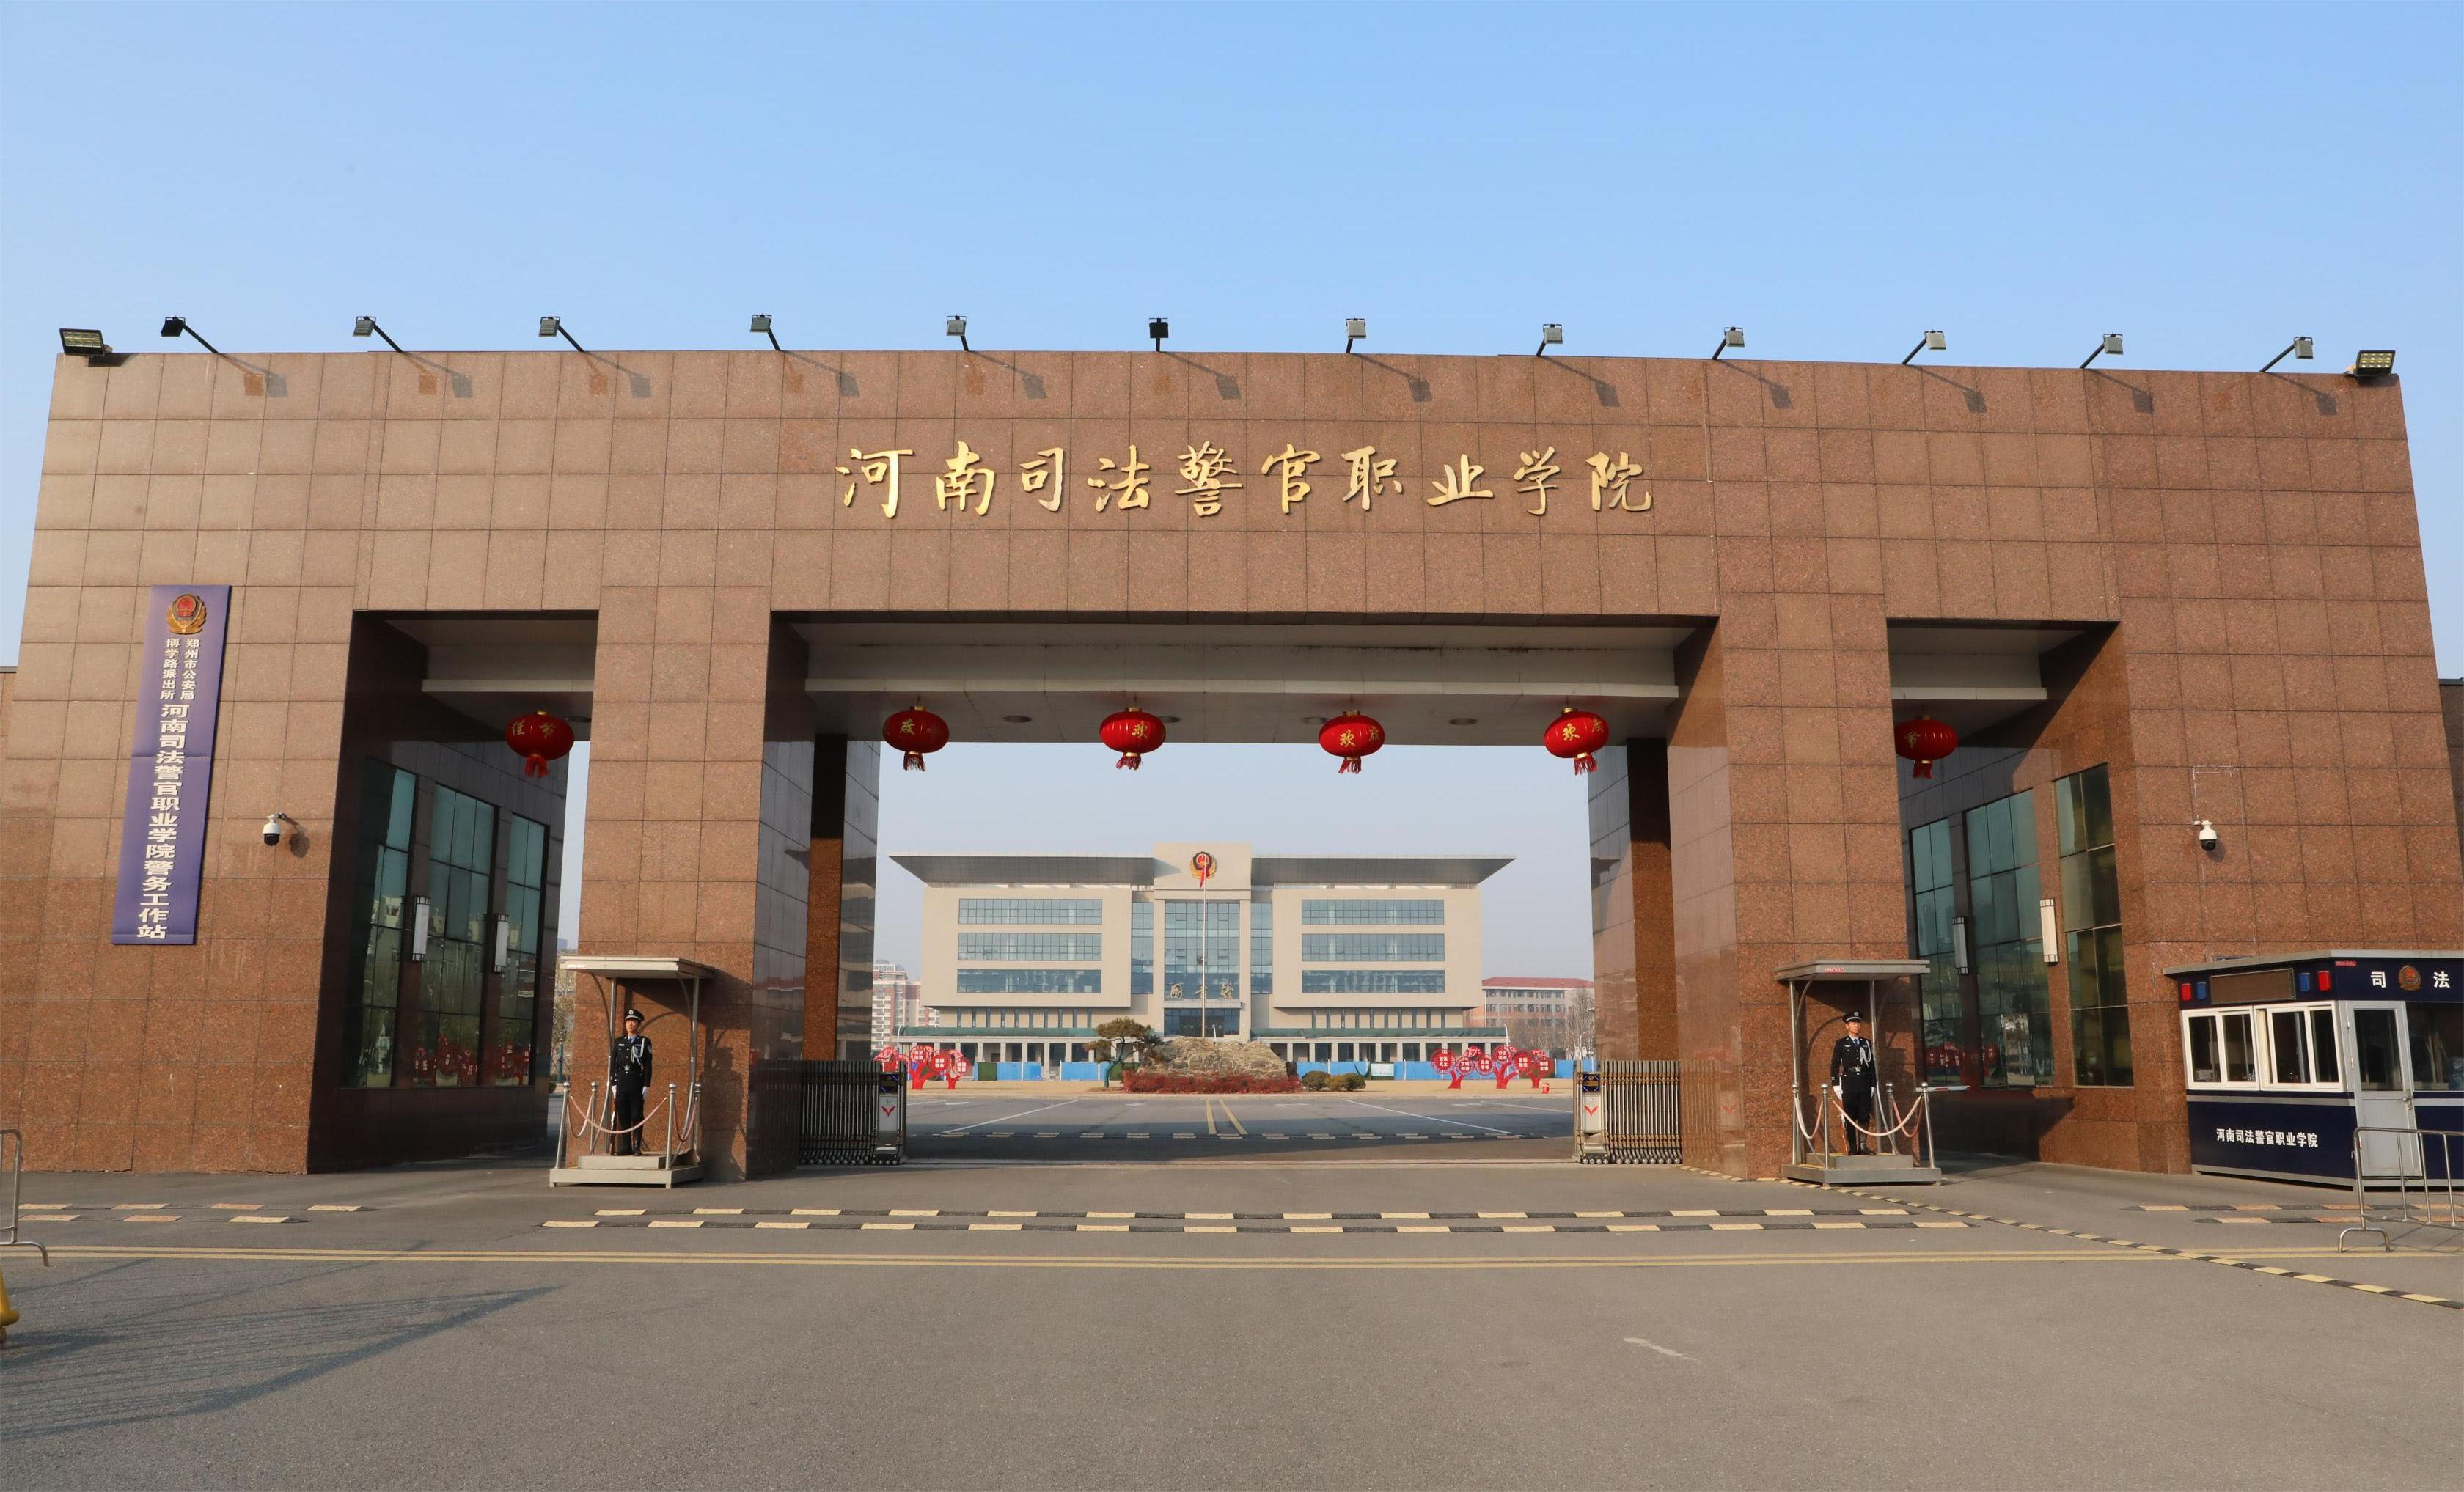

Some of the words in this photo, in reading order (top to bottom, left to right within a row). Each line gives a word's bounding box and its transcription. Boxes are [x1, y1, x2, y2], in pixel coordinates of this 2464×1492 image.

[835, 440, 1652, 519] 河南司法警官职业学院
[160, 637, 180, 700] 博学路派出所
[180, 638, 201, 701] 郑州市公安局
[136, 703, 191, 940] 河南司法警官职业学院警务工作站
[2216, 1128, 2319, 1148] 河南司法警官职业学院
